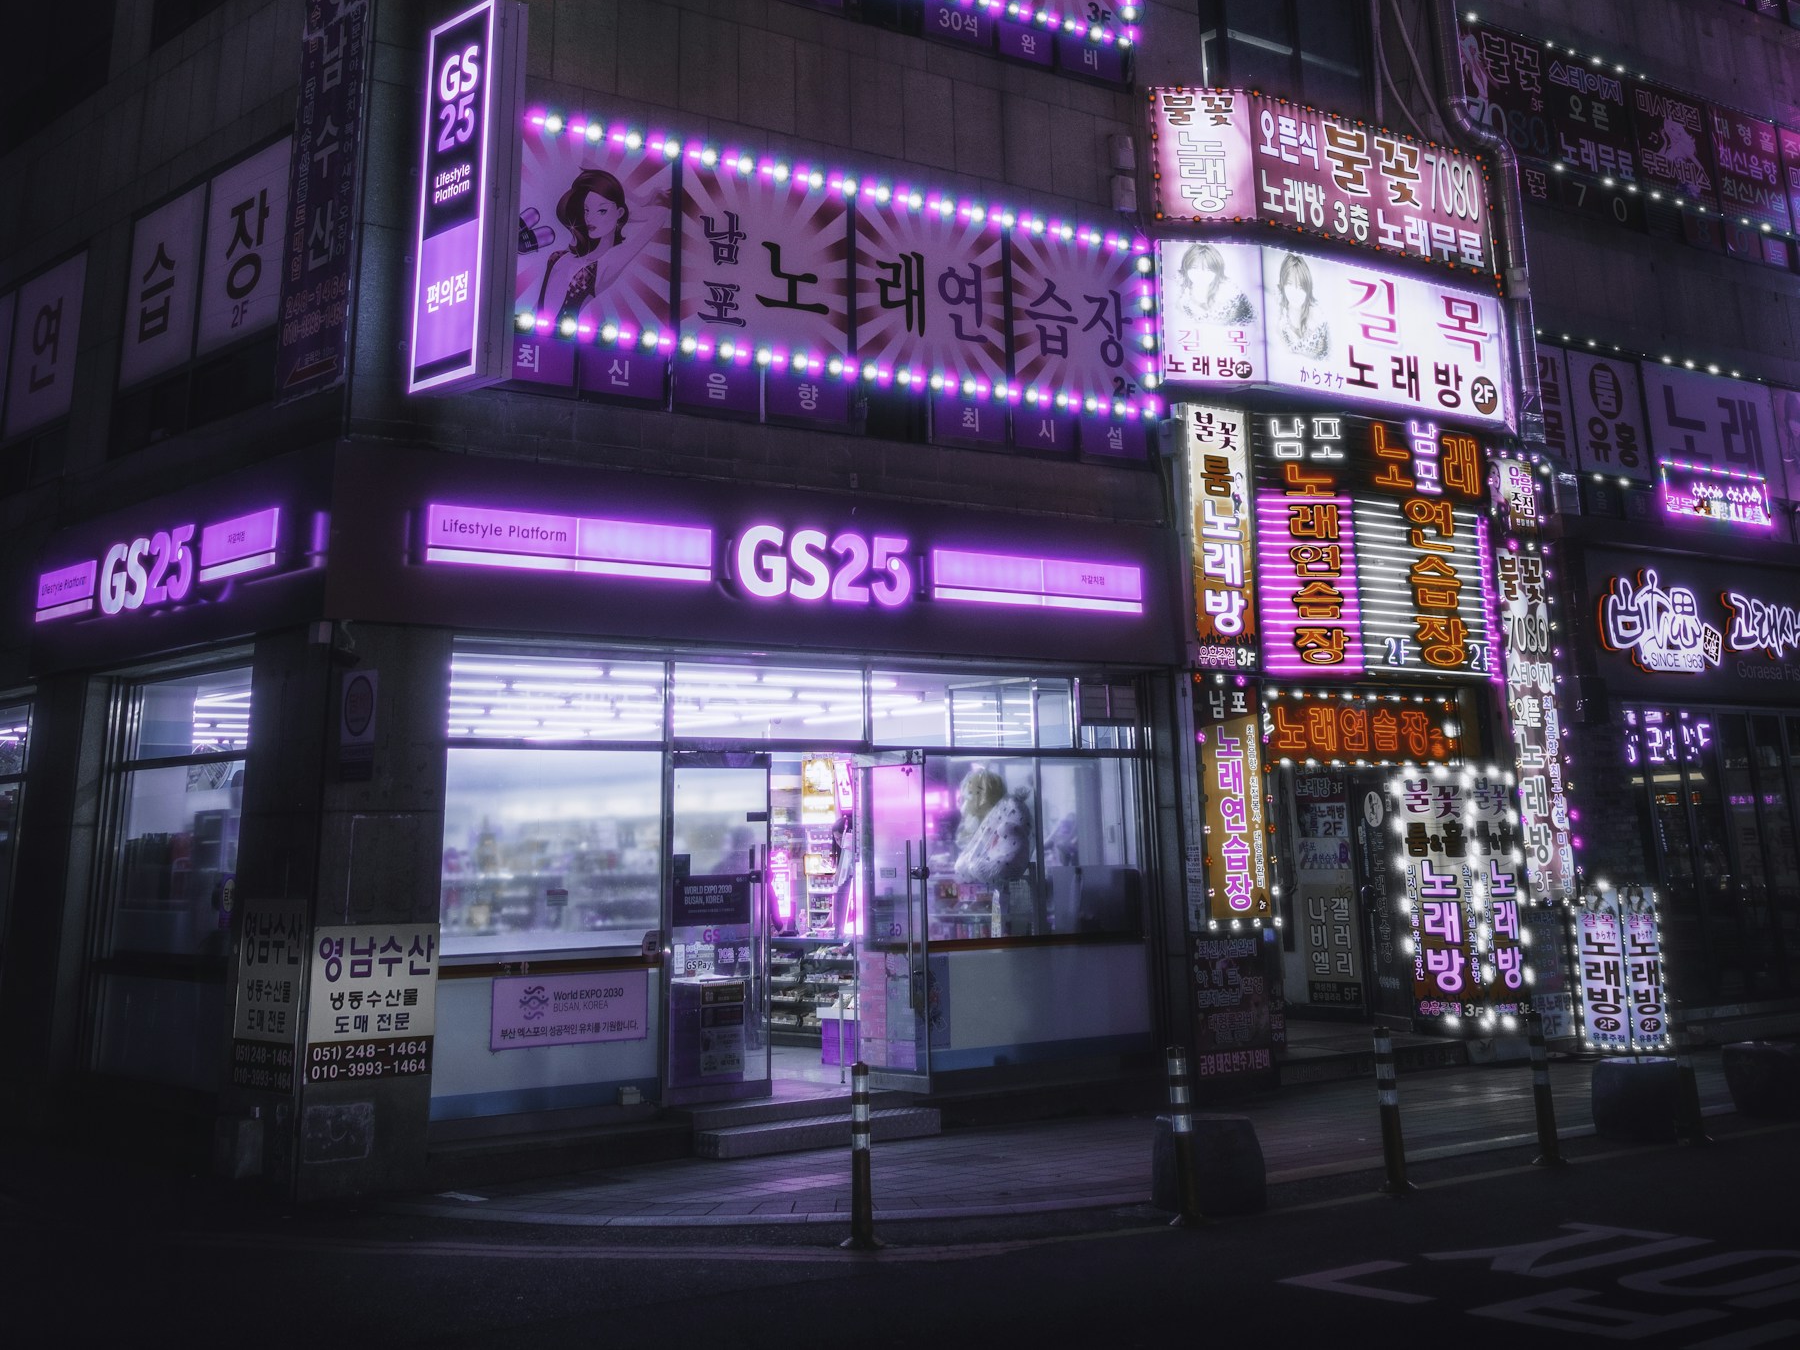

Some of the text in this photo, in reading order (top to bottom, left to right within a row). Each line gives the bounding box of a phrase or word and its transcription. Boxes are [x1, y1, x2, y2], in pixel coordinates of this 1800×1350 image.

[937, 6, 980, 39] 30석
[440, 44, 479, 104] GS
[1480, 31, 1542, 94] 불꽃
[1548, 59, 1624, 106] 스테이지
[438, 91, 476, 152] 25
[1162, 93, 1235, 128] 불꽃
[1569, 94, 1610, 132] 오픈
[1176, 131, 1233, 213] 노래방
[1258, 108, 1480, 223] 오픈식 불꽃 7080
[1559, 131, 1636, 182] 노래무료
[1719, 150, 1778, 186] 최신음향
[434, 162, 471, 189] Lifestyle
[434, 178, 471, 205] Platform
[1261, 168, 1485, 268] 노래방 3층 노래무료
[426, 270, 469, 314] 편의점
[699, 209, 748, 329] 남포
[754, 238, 1133, 370] 노래연습장
[231, 300, 249, 330] 2F
[1346, 276, 1489, 364] 길목
[1177, 327, 1251, 355] 길목
[1166, 353, 1252, 379] 노래방 2F
[1299, 364, 1345, 391] からオケ
[1345, 344, 1496, 409] 노래방 2F
[1193, 410, 1239, 452] 불꽃
[1269, 415, 1345, 462] 남포
[1408, 418, 1443, 495] 남포
[441, 518, 567, 543] Lifestyle Platform
[100, 523, 196, 615] GS25
[737, 524, 911, 607] GS25
[1283, 461, 1350, 666] 노래연습장
[1498, 554, 1543, 604] 불꽃
[1080, 573, 1106, 586] 자갈치점
[1502, 615, 1549, 655] 7080
[1199, 646, 1256, 668] 유흥주점 3F
[1650, 652, 1704, 669] SINCE 1963
[1736, 660, 1783, 680] Goraesa
[1509, 662, 1553, 688] 스테이지
[1207, 689, 1248, 720] 남포
[1514, 697, 1542, 729] 오픈
[1277, 706, 1429, 757] 노래연습장
[1295, 777, 1344, 798] 노래방 3F
[1402, 778, 1463, 819] 불꽃
[1473, 776, 1509, 816] 불꽃
[1520, 732, 1553, 866] 노래방
[1214, 724, 1254, 912] 노래연습장
[1323, 821, 1343, 836] 2F
[683, 884, 733, 895] WORLD EXPO 2030
[1535, 870, 1553, 893] 3F
[684, 894, 724, 906] BUSAN, KOREA
[1308, 896, 1331, 975] 나비엘
[1420, 859, 1466, 992] 노래방
[1490, 859, 1523, 989] 노래방
[1581, 913, 1615, 929] 길목
[1627, 914, 1654, 929] 길목
[1330, 896, 1354, 978] 갤러리
[318, 934, 435, 983] 영남수산
[1582, 932, 1625, 1015] 노래방
[1242, 976, 1264, 995] 환영
[1628, 933, 1663, 1016] 노래방
[246, 979, 291, 1004] 냉동수산물
[329, 987, 419, 1011] 냉동수산물
[553, 987, 624, 1001] World EXPO 2030
[553, 1000, 609, 1013] BUSAN, KOREA
[1344, 987, 1359, 1002] 5F
[246, 1009, 286, 1034] 도매 전문
[333, 1012, 410, 1034] 도매 전문
[1464, 1003, 1484, 1017] 3F
[1544, 1014, 1562, 1036] 2F
[1599, 1020, 1616, 1030] 2F
[1644, 1021, 1657, 1030] 2F
[500, 1019, 639, 1040] 부산 엑스포의 성공적인 유치를 기원합니다.
[1592, 1032, 1626, 1043] 유흥주점
[1638, 1033, 1665, 1043] 유흥주점
[233, 1066, 291, 1091] 010-3993-1464
[311, 1058, 426, 1080] 010-3993-1464
